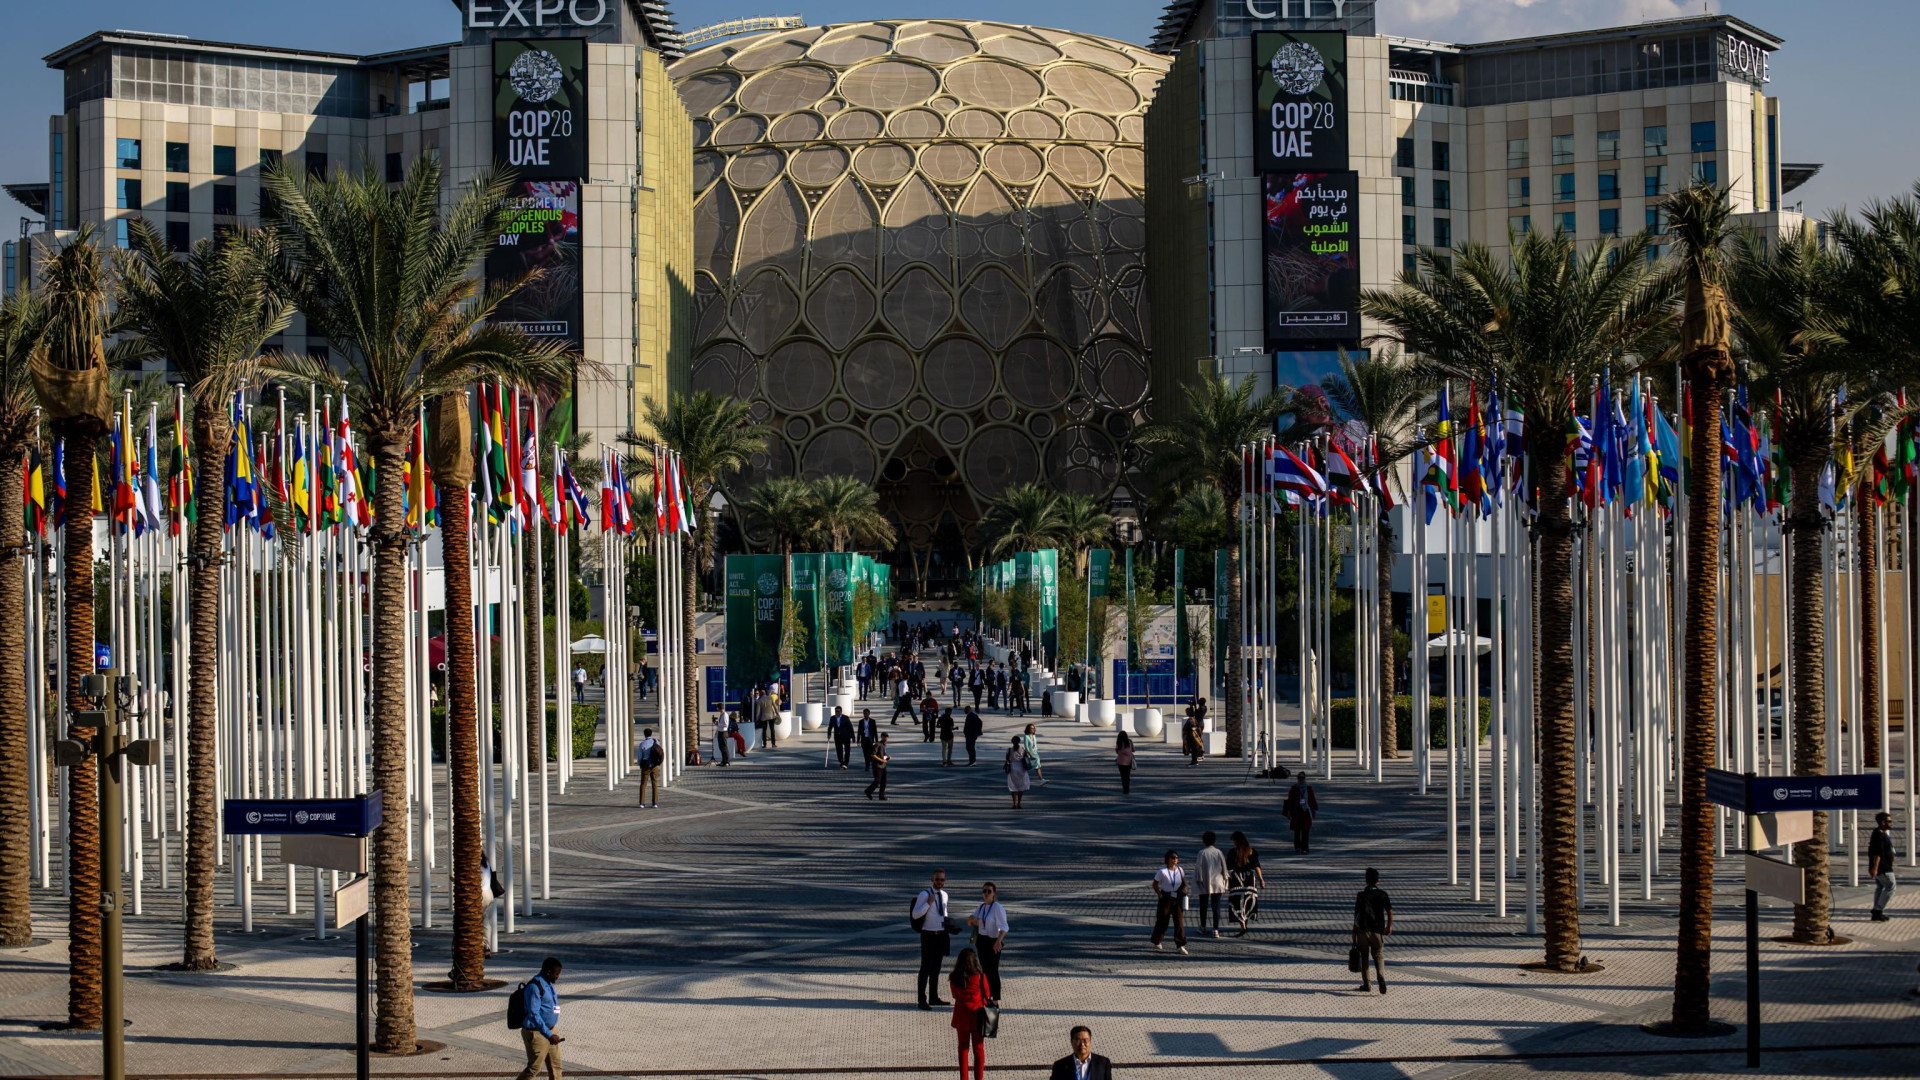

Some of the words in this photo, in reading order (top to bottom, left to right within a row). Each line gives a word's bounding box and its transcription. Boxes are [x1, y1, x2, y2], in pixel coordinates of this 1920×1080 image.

[468, 0, 606, 27] EXPO
[1727, 34, 1770, 83] ROVE
[508, 109, 572, 138] COP28
[1271, 102, 1334, 130] COP28
[1271, 130, 1313, 158] UAE
[509, 139, 550, 166] UAE
[552, 197, 566, 209] TO
[1294, 187, 1316, 203] بكم
[1309, 205, 1329, 219] يوم
[1330, 202, 1348, 219] في
[1303, 220, 1349, 237] الشعوب
[499, 233, 520, 246] DAY
[1310, 239, 1349, 255] الأصلية
[828, 590, 852, 602] COP28
[758, 609, 775, 621] UAE
[829, 602, 844, 612] UAE
